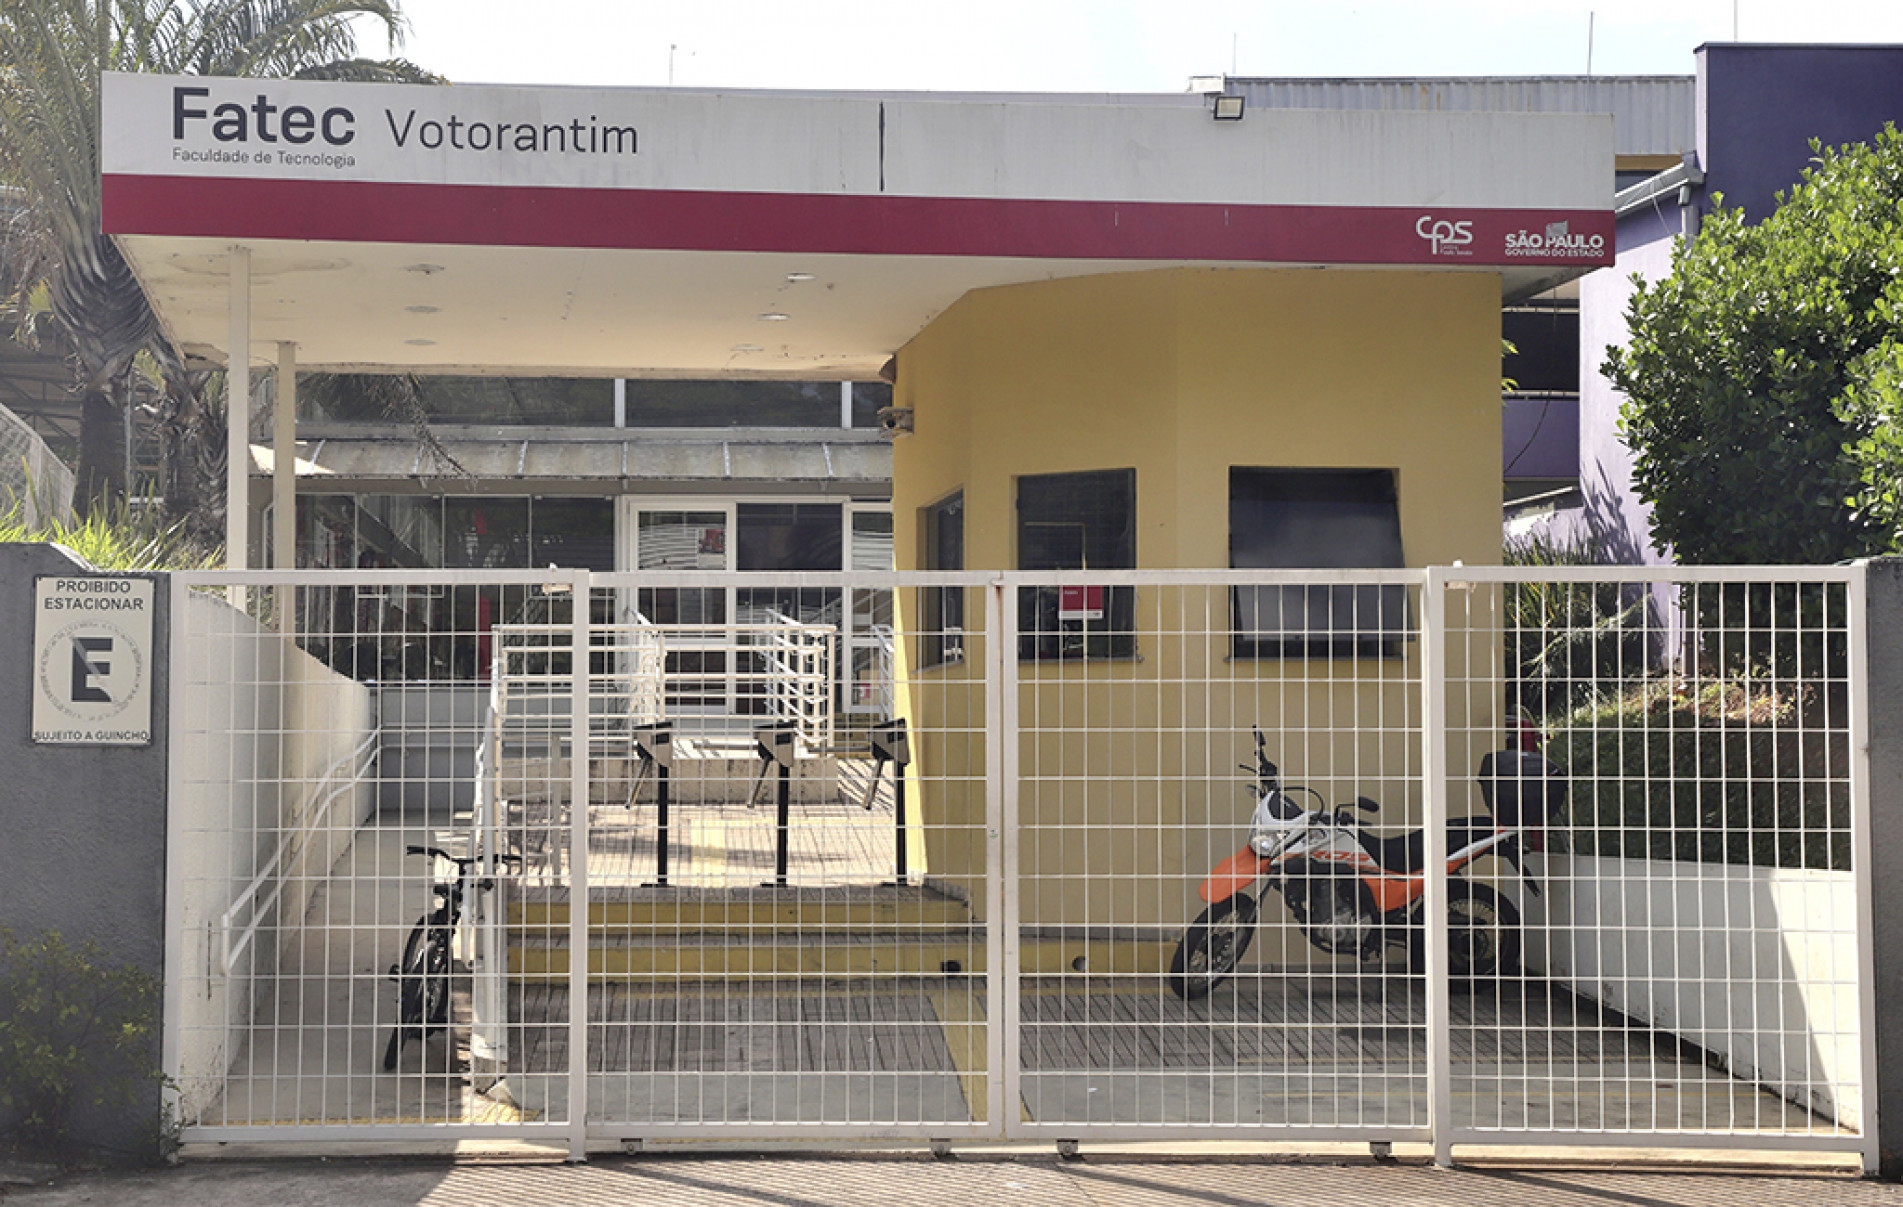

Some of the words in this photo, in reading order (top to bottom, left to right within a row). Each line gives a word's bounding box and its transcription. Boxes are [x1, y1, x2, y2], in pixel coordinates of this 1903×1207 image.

[173, 86, 356, 146] Fatec
[384, 108, 639, 154] Votorantim
[172, 147, 250, 164] Faculdade
[253, 150, 273, 164] de
[277, 150, 356, 169] Tecnologia
[1504, 229, 1543, 248] SÃO
[1545, 233, 1605, 248] PAULO
[1504, 248, 1551, 257] GOVERNO
[1551, 248, 1566, 257] DO
[1567, 248, 1605, 258] ESTADO
[55, 580, 132, 593] PROIBIDO
[44, 597, 144, 611] ESTACIONAR
[34, 731, 82, 741] SUJEITO
[84, 731, 94, 741] A
[95, 731, 149, 741] GUINCHO
